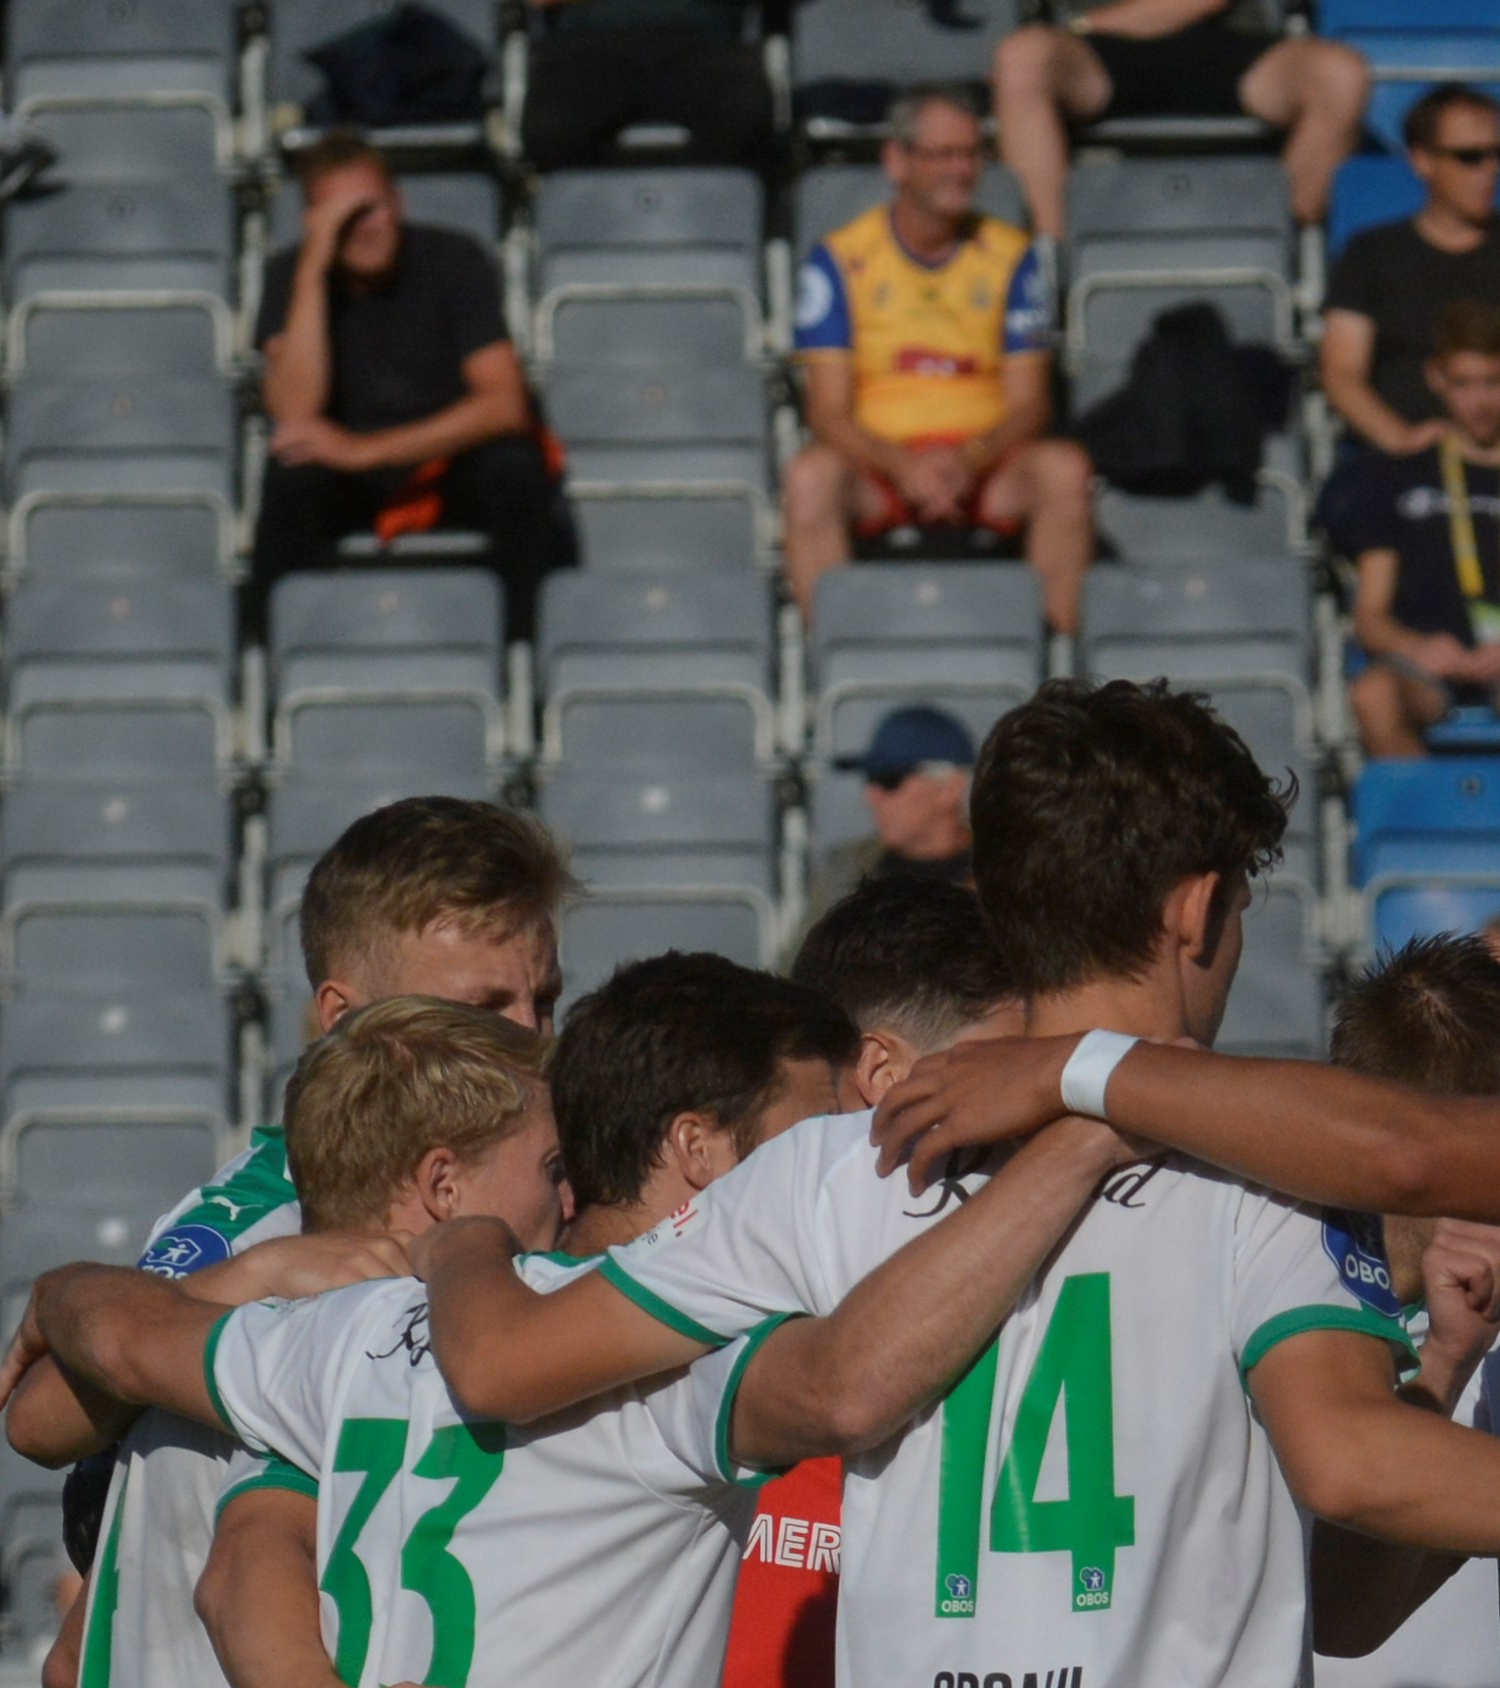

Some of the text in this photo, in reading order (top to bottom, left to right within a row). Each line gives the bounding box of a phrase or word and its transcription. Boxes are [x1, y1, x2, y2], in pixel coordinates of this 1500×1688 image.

[934, 1271, 1135, 1618] 14
[941, 1598, 975, 1614] OBOS
[1076, 1591, 1110, 1607] OBOS
